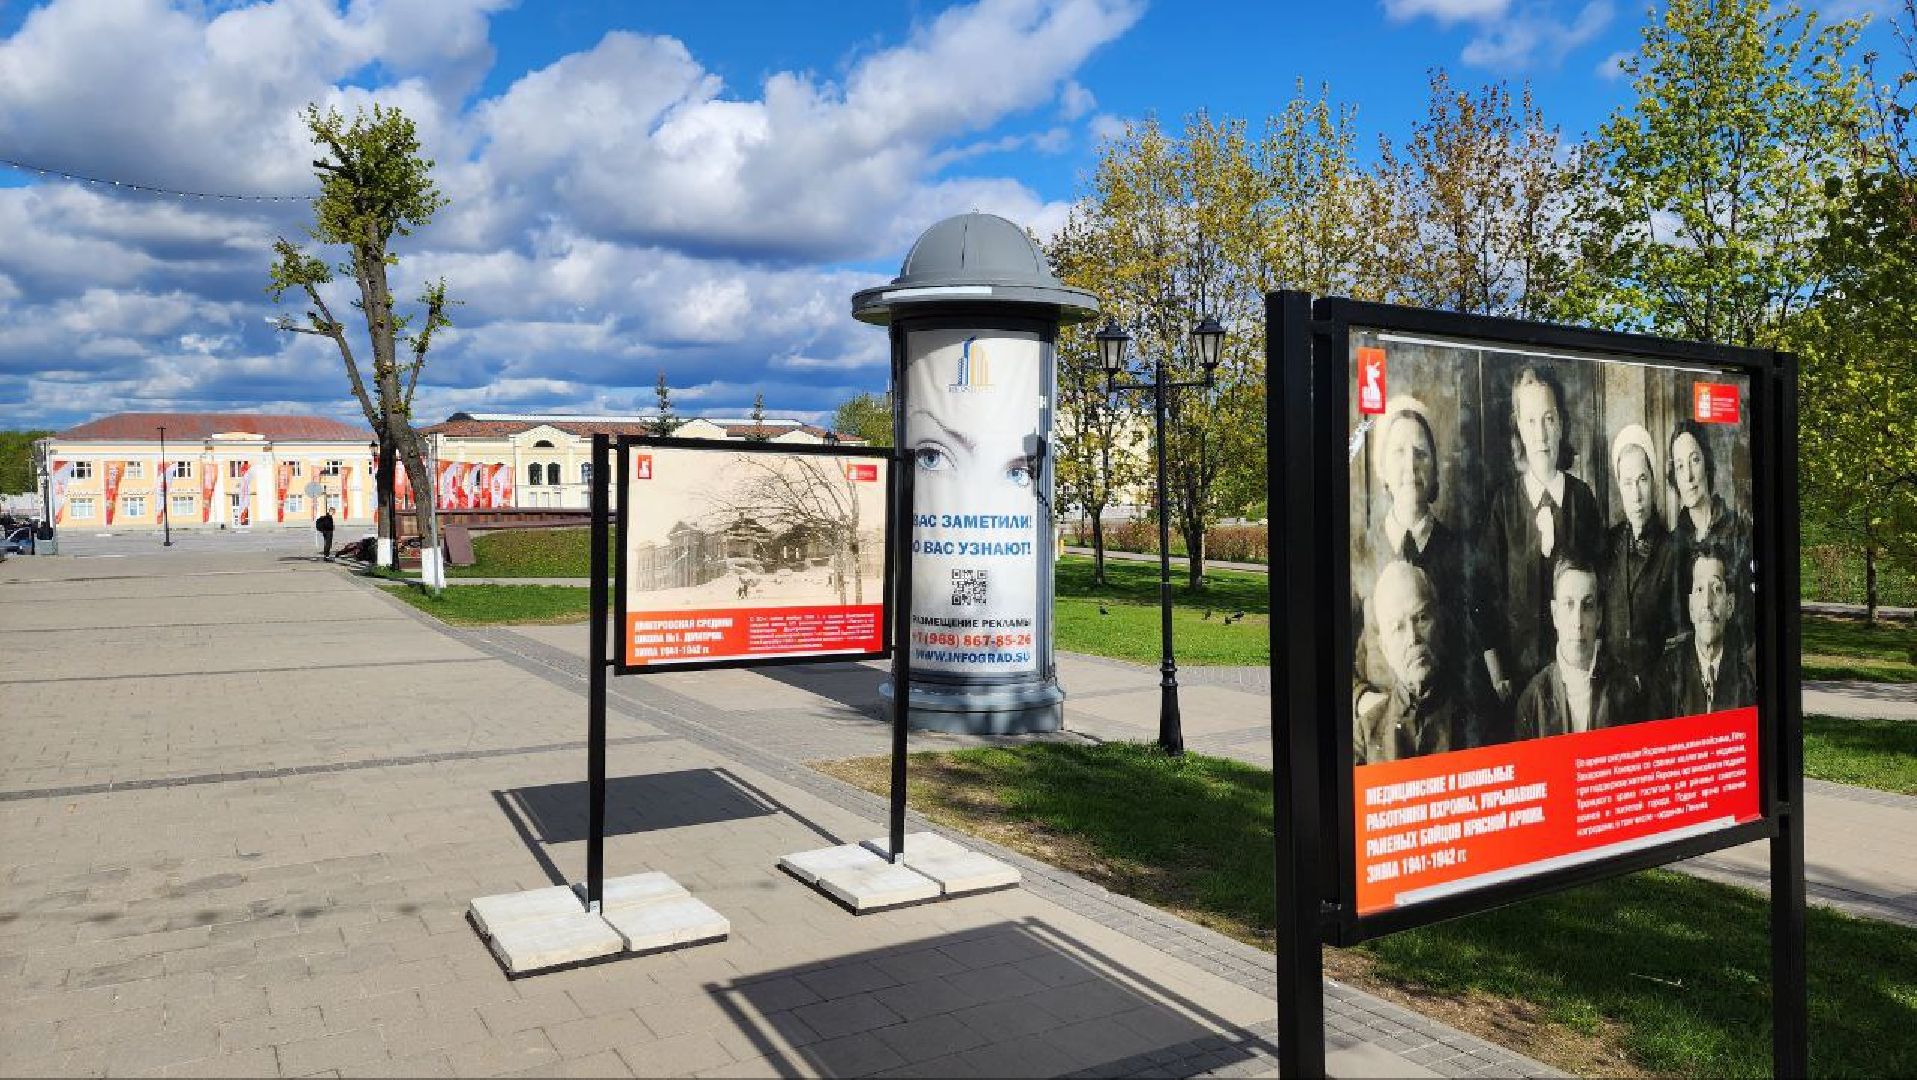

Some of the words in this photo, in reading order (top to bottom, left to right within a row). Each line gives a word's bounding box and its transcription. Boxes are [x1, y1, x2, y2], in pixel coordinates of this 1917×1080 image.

[941, 514, 1032, 528] ЗАМЕТИЛИ!
[923, 541, 954, 555] ВАС
[958, 541, 1031, 555] УЗНАЮТ!
[1365, 775, 1446, 806] МЕДИЦИНСКИЕ
[1448, 774, 1456, 791] И
[1458, 765, 1514, 790] ШКОЛЬНЫЕ
[1365, 803, 1427, 832] РАБОТНИКИ
[1481, 783, 1547, 811] УКРЫВАВШИЕ
[1366, 831, 1417, 858] РАНЕНЫХ
[1420, 822, 1461, 847] БОЙЦОВ
[1464, 811, 1506, 838] КРАСНОЙ
[1366, 860, 1398, 884] ЗИМА
[1403, 848, 1455, 874] 1941-1942
